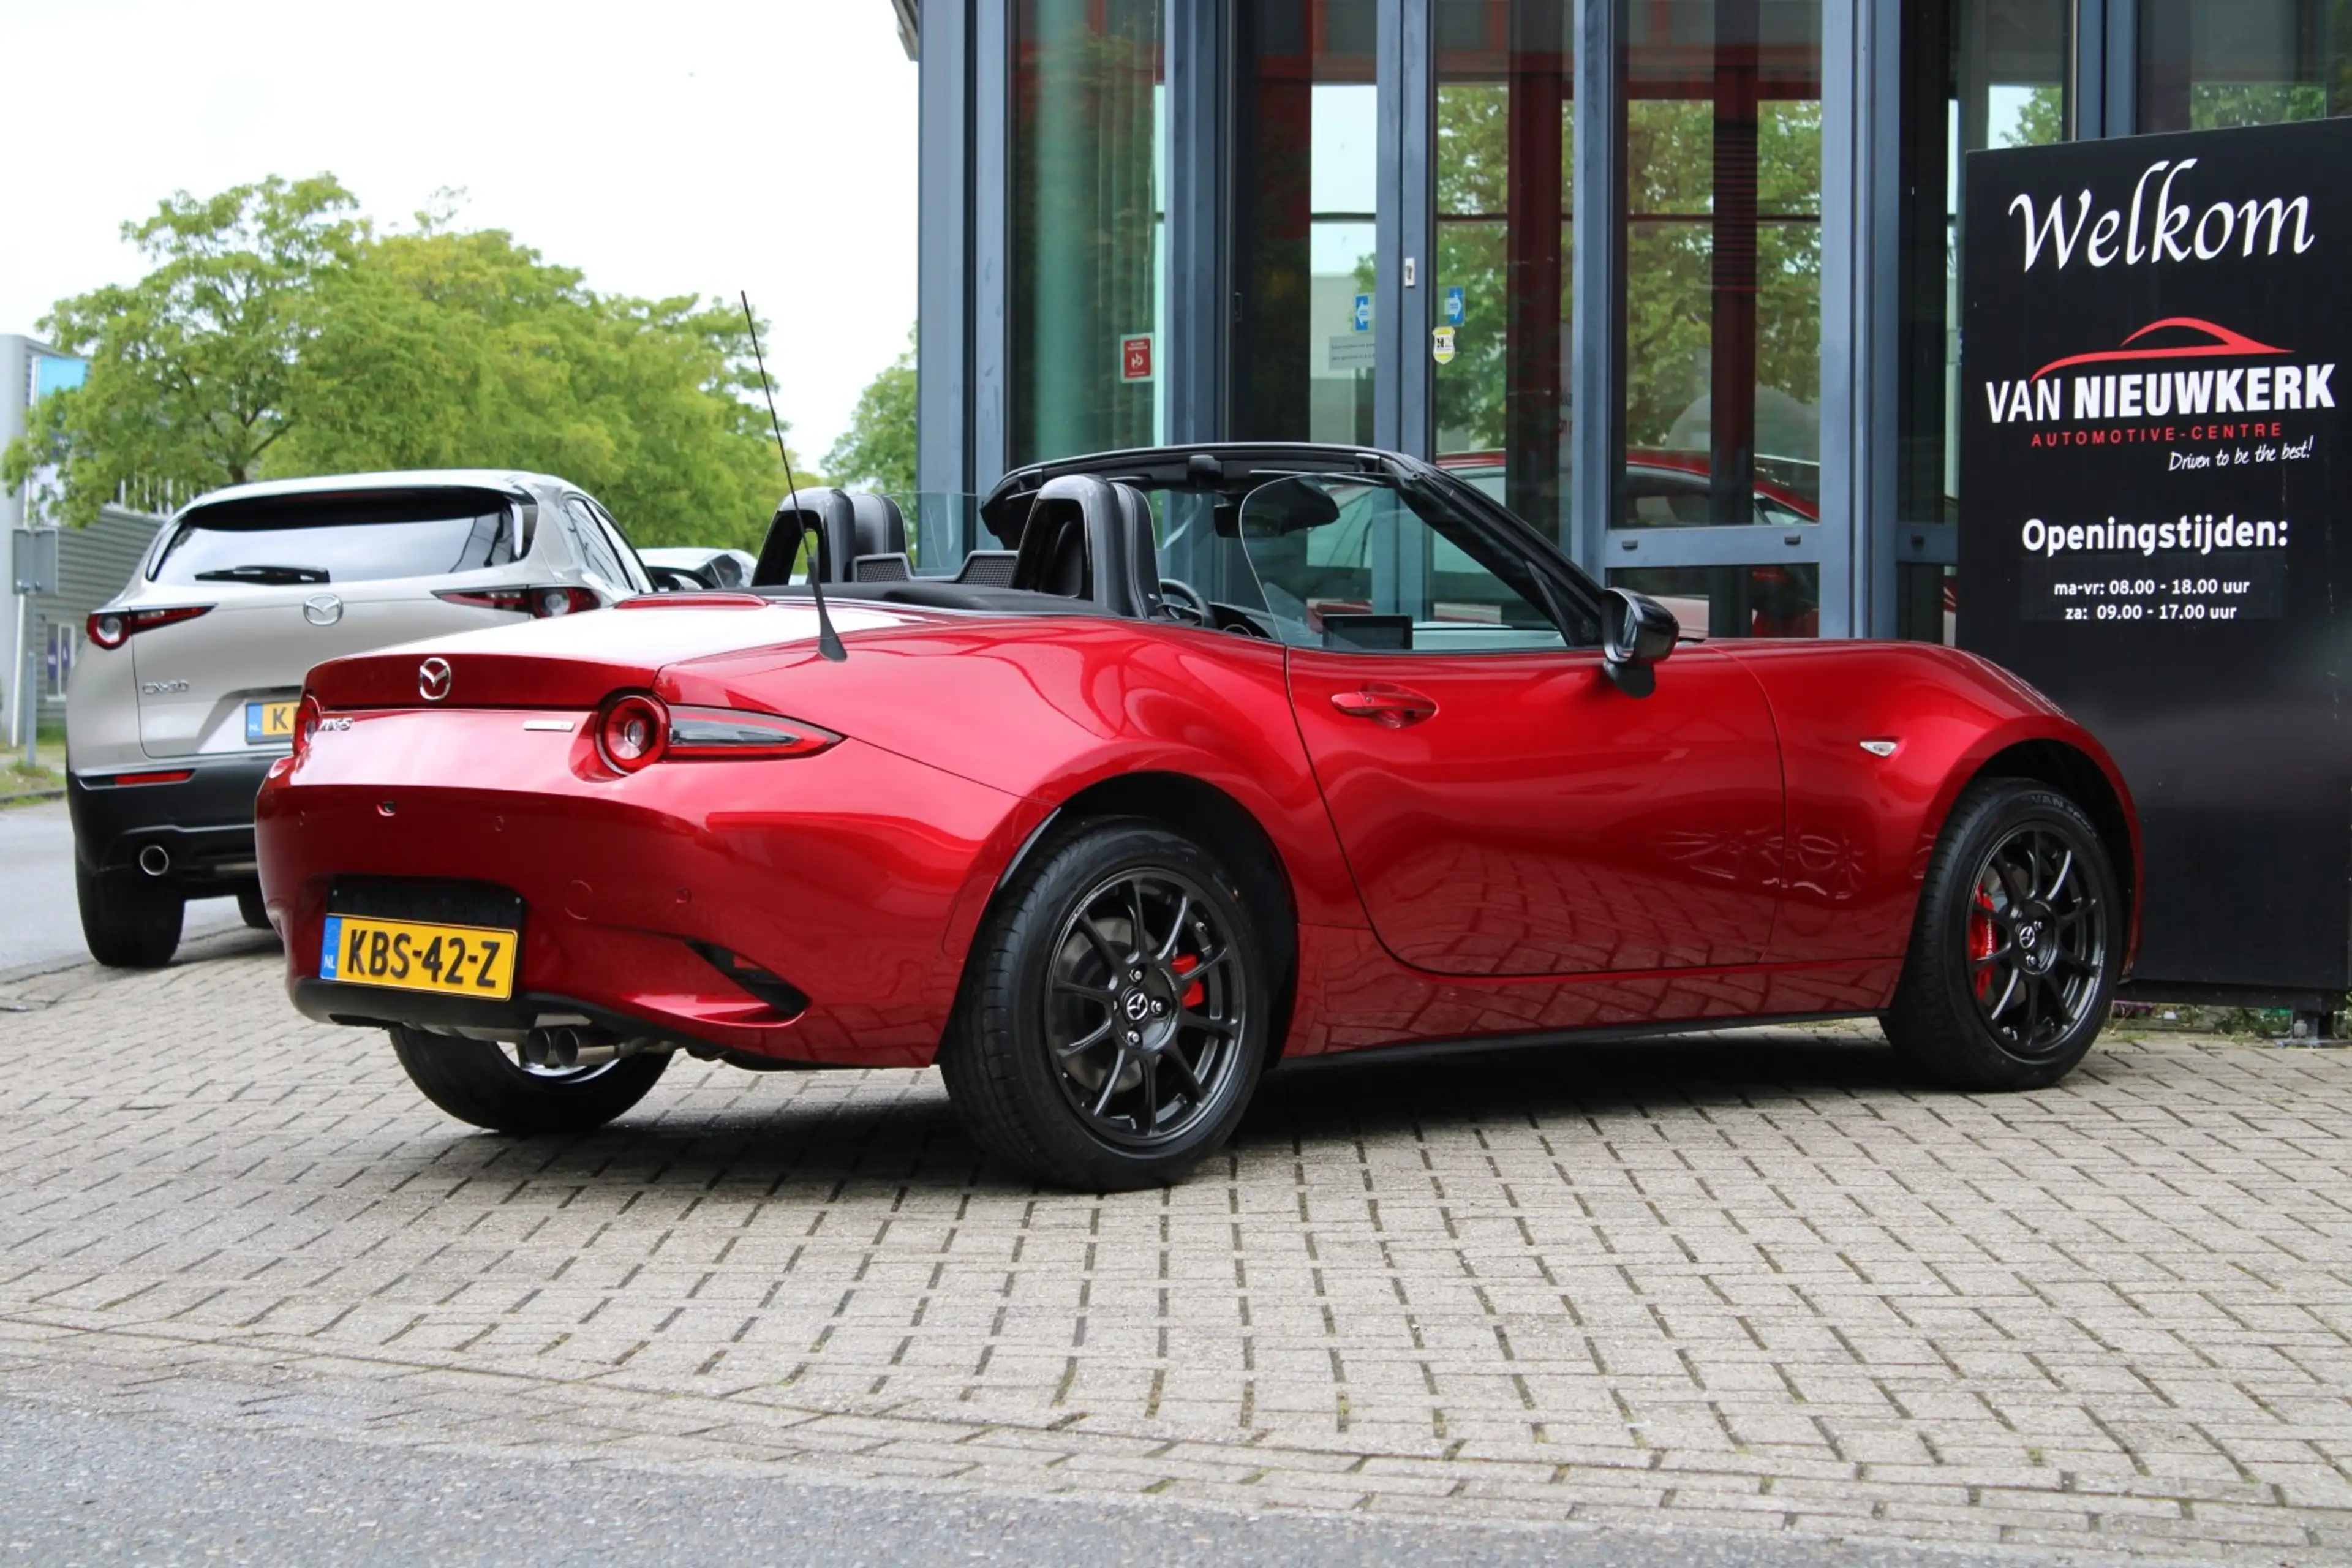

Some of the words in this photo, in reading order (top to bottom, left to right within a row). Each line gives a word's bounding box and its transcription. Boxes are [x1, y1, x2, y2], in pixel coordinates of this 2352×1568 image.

[2008, 158, 2315, 273] Welkom
[1986, 378, 2062, 423] VAN
[2074, 364, 2336, 420] NIEUWKERK
[2031, 423, 2282, 447] AUTOMOTIVE-CENTRE
[2168, 451, 2211, 471] Driven
[2215, 449, 2230, 467] to
[2234, 447, 2250, 465] be
[2255, 444, 2276, 463] the
[2282, 435, 2314, 460] best!
[2022, 514, 2288, 557] Openingstijden:
[2054, 583, 2105, 596] ma-vr:
[2109, 579, 2156, 595] 08.00
[2172, 579, 2218, 595] 18.00
[2223, 581, 2251, 594] uur
[2065, 608, 2089, 620] za:
[2097, 605, 2143, 620] 09.00
[2160, 604, 2206, 620] 17.00
[2210, 606, 2237, 620] uur
[324, 954, 336, 970] NL
[347, 929, 500, 988] KBS-42-Z
